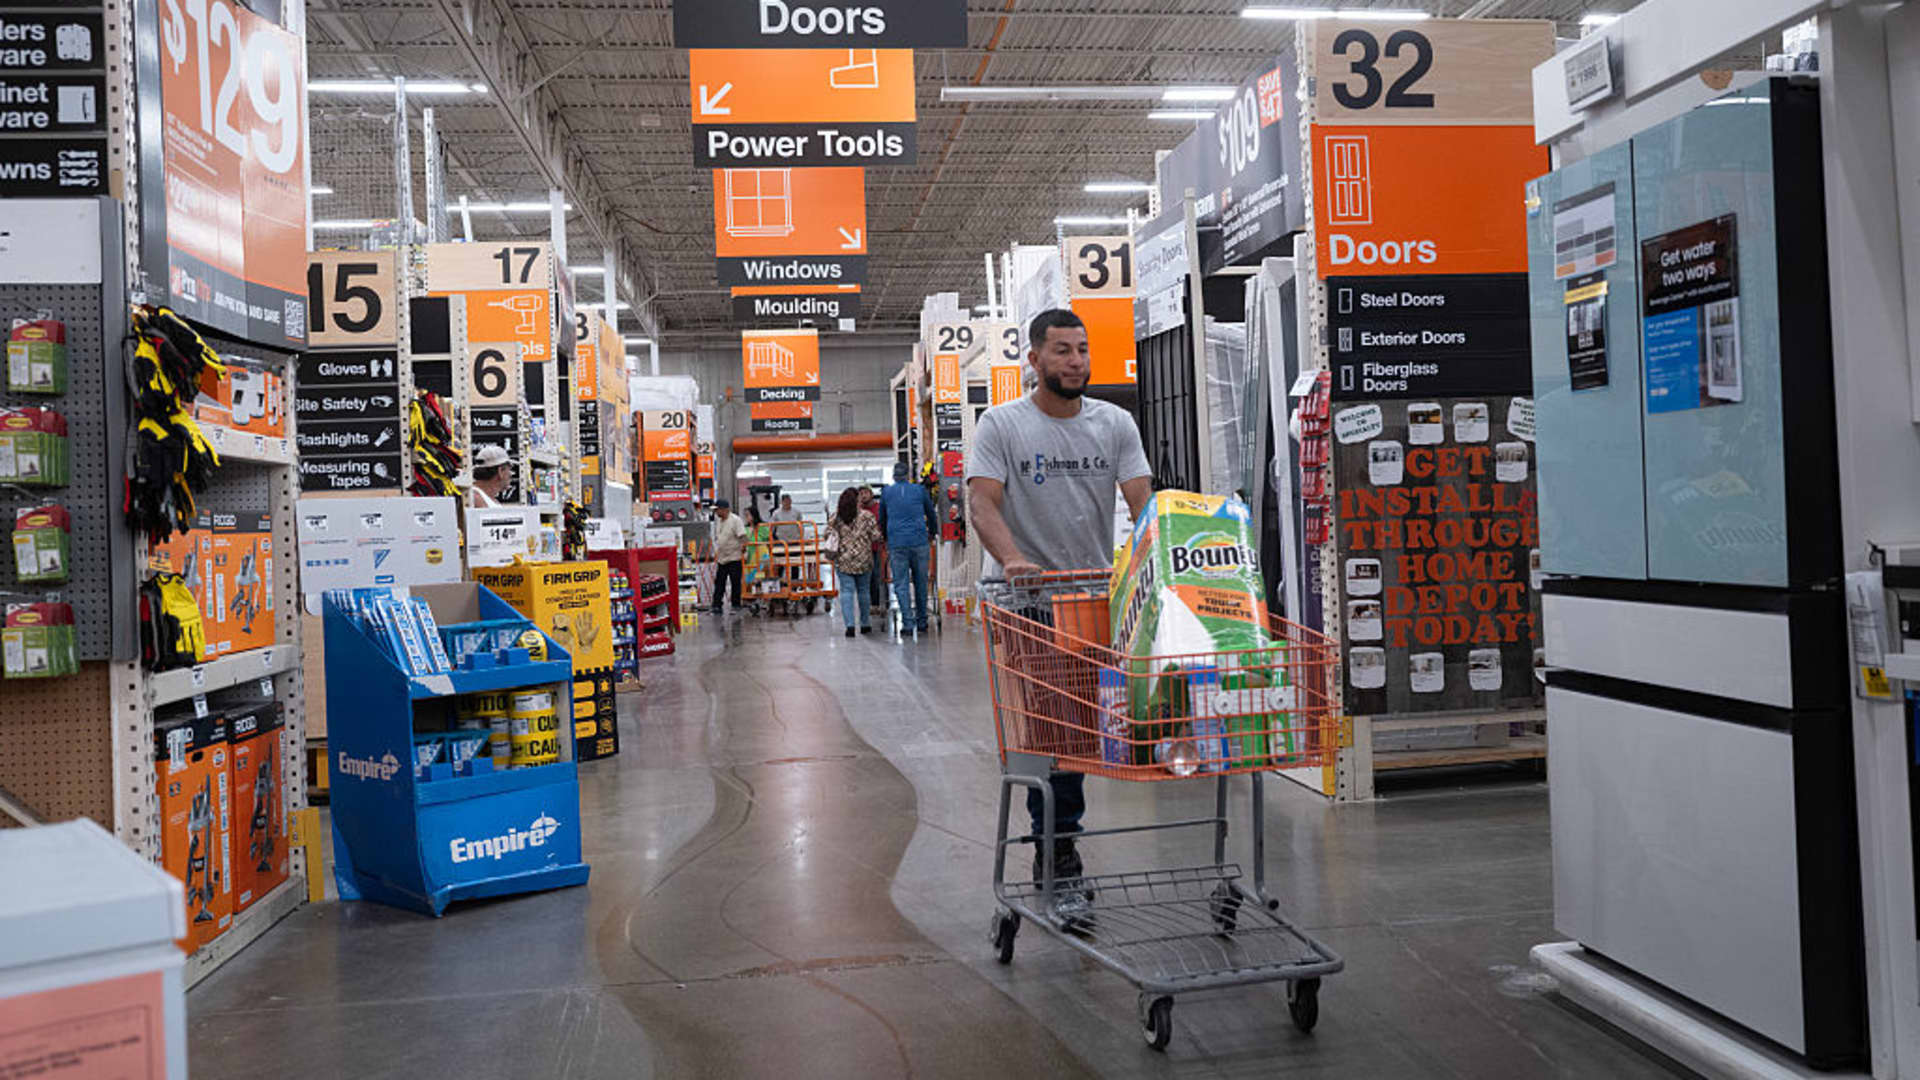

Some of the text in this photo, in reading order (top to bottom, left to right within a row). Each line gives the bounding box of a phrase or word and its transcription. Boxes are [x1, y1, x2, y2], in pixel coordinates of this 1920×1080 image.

[759, 0, 886, 35] Doors
[1332, 29, 1435, 110] 32
[708, 129, 904, 158] Power Tools
[1329, 233, 1437, 265] Doors
[1660, 240, 1717, 267] Get water
[493, 247, 541, 284] 17
[743, 260, 843, 280] Windows
[1078, 242, 1132, 290] 31
[1662, 261, 1717, 287] two ways
[307, 262, 383, 334] 15
[754, 298, 840, 318] Moulding
[1361, 293, 1445, 308] Steel Doors
[938, 326, 974, 351] 29
[1361, 330, 1466, 346] Exterior Doors
[318, 362, 367, 376] Gloves
[1363, 363, 1439, 379] Fiberglass
[760, 389, 805, 401] Decking
[1364, 379, 1408, 392] Doors
[322, 396, 367, 413] Safety
[661, 412, 684, 429] 20
[1406, 446, 1490, 478] GET
[328, 474, 371, 488] Tapes
[1170, 546, 1260, 574] Bounty
[1397, 551, 1515, 583] HOME
[543, 570, 601, 586] FIRM GRIP
[1386, 582, 1525, 616] DEPOT
[1386, 612, 1537, 647] TODAY!
[338, 752, 391, 781] Empire
[450, 827, 545, 864] Empire
